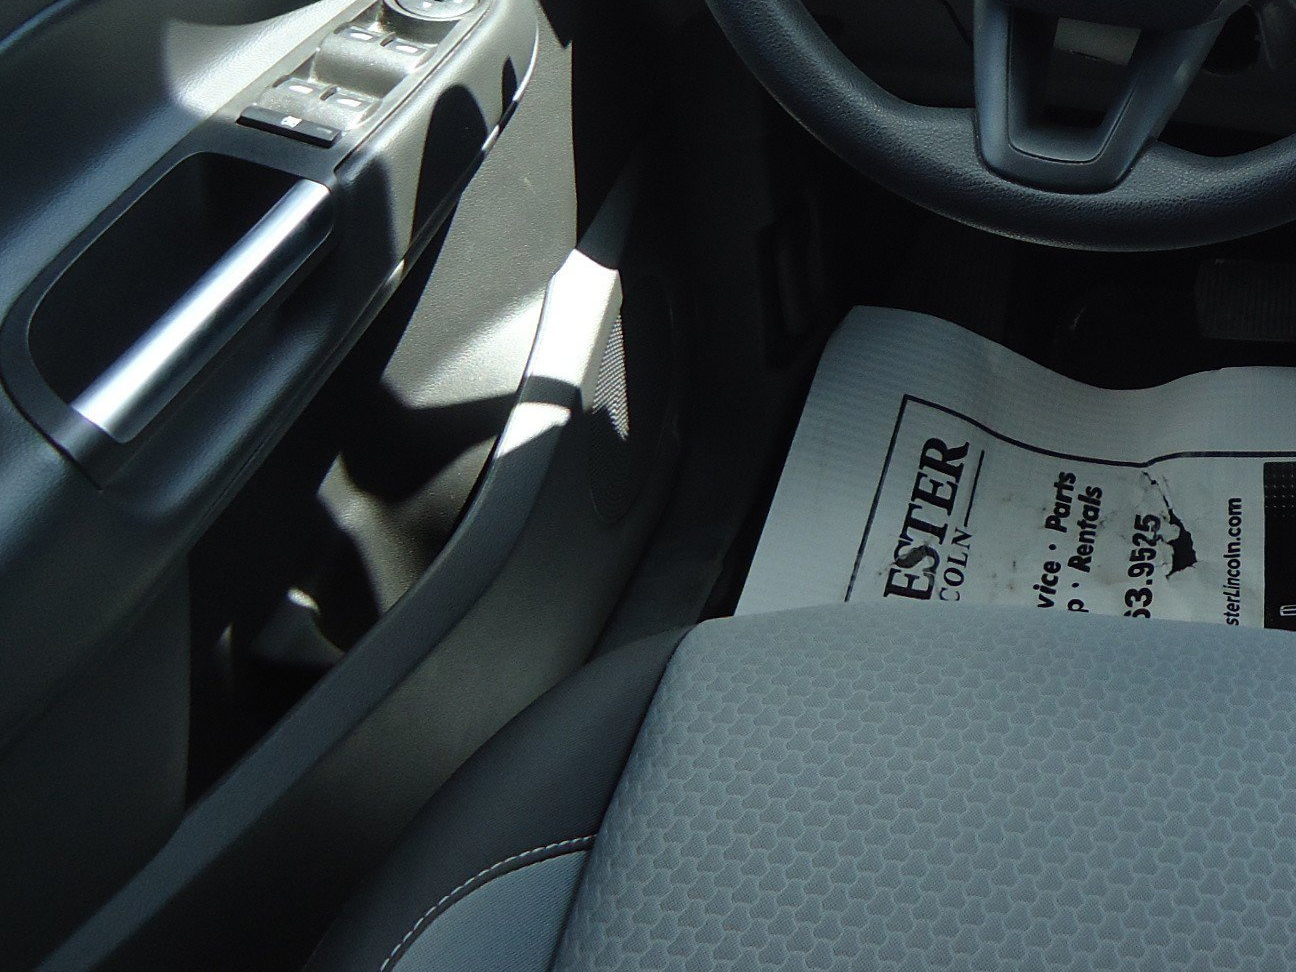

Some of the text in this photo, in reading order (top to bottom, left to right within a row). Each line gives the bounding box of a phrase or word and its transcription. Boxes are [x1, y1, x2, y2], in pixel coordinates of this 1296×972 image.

[883, 437, 970, 601] ESTER
[1033, 471, 1077, 608] vice Parts
[1067, 485, 1103, 572] Rentals
